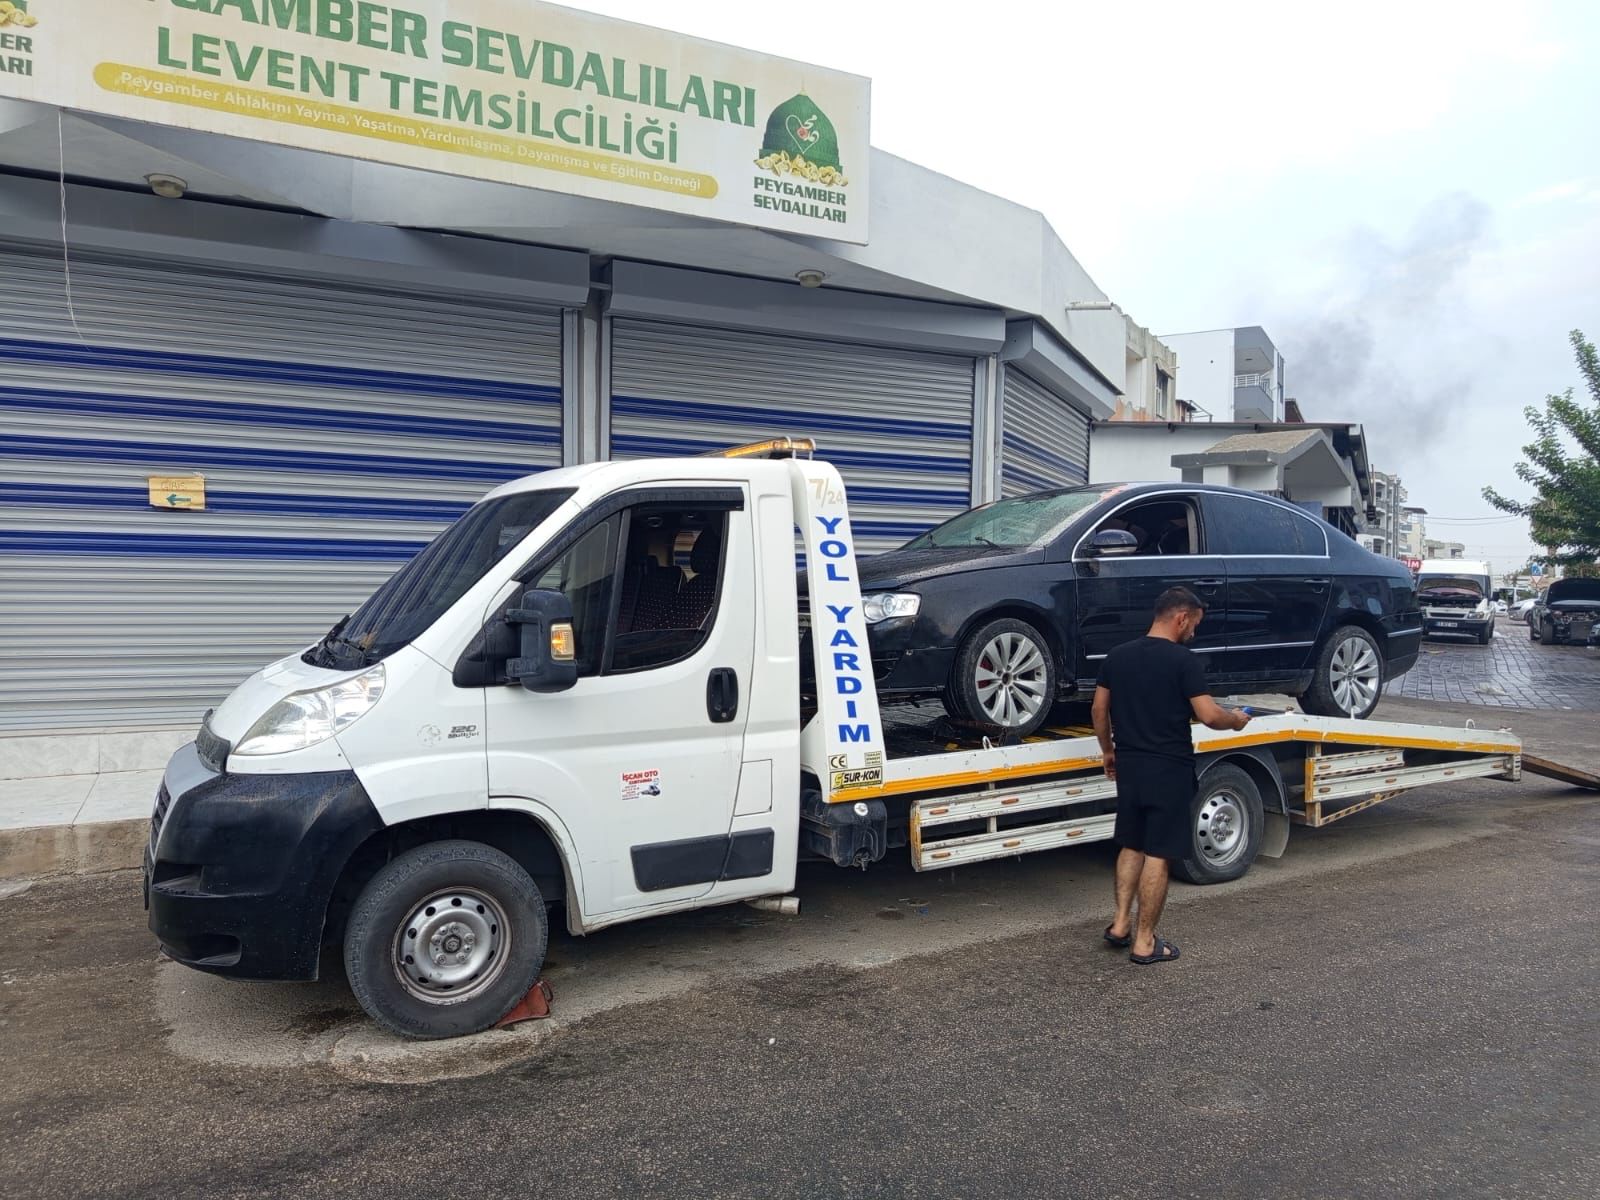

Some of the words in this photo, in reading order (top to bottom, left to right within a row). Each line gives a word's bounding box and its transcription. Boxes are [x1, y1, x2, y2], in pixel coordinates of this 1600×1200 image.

[157, 26, 370, 102] LEVENT
[380, 70, 678, 164] TEMSİLCİLİĞİ
[441, 21, 756, 128] SEVDALILARI
[120, 71, 219, 103] Peygamber
[295, 104, 350, 127] Yayma,
[518, 145, 590, 169] Dayanışma
[593, 161, 609, 173] ve
[610, 161, 651, 181] Eğitim
[653, 171, 701, 191] Derneği
[754, 176, 846, 206] PEYGAMBER
[754, 194, 847, 223] SEVDALILARI
[815, 516, 850, 582] YOL
[826, 604, 872, 743] YARDIM
[830, 755, 847, 769] CE
[843, 769, 881, 784] SUR-KON
